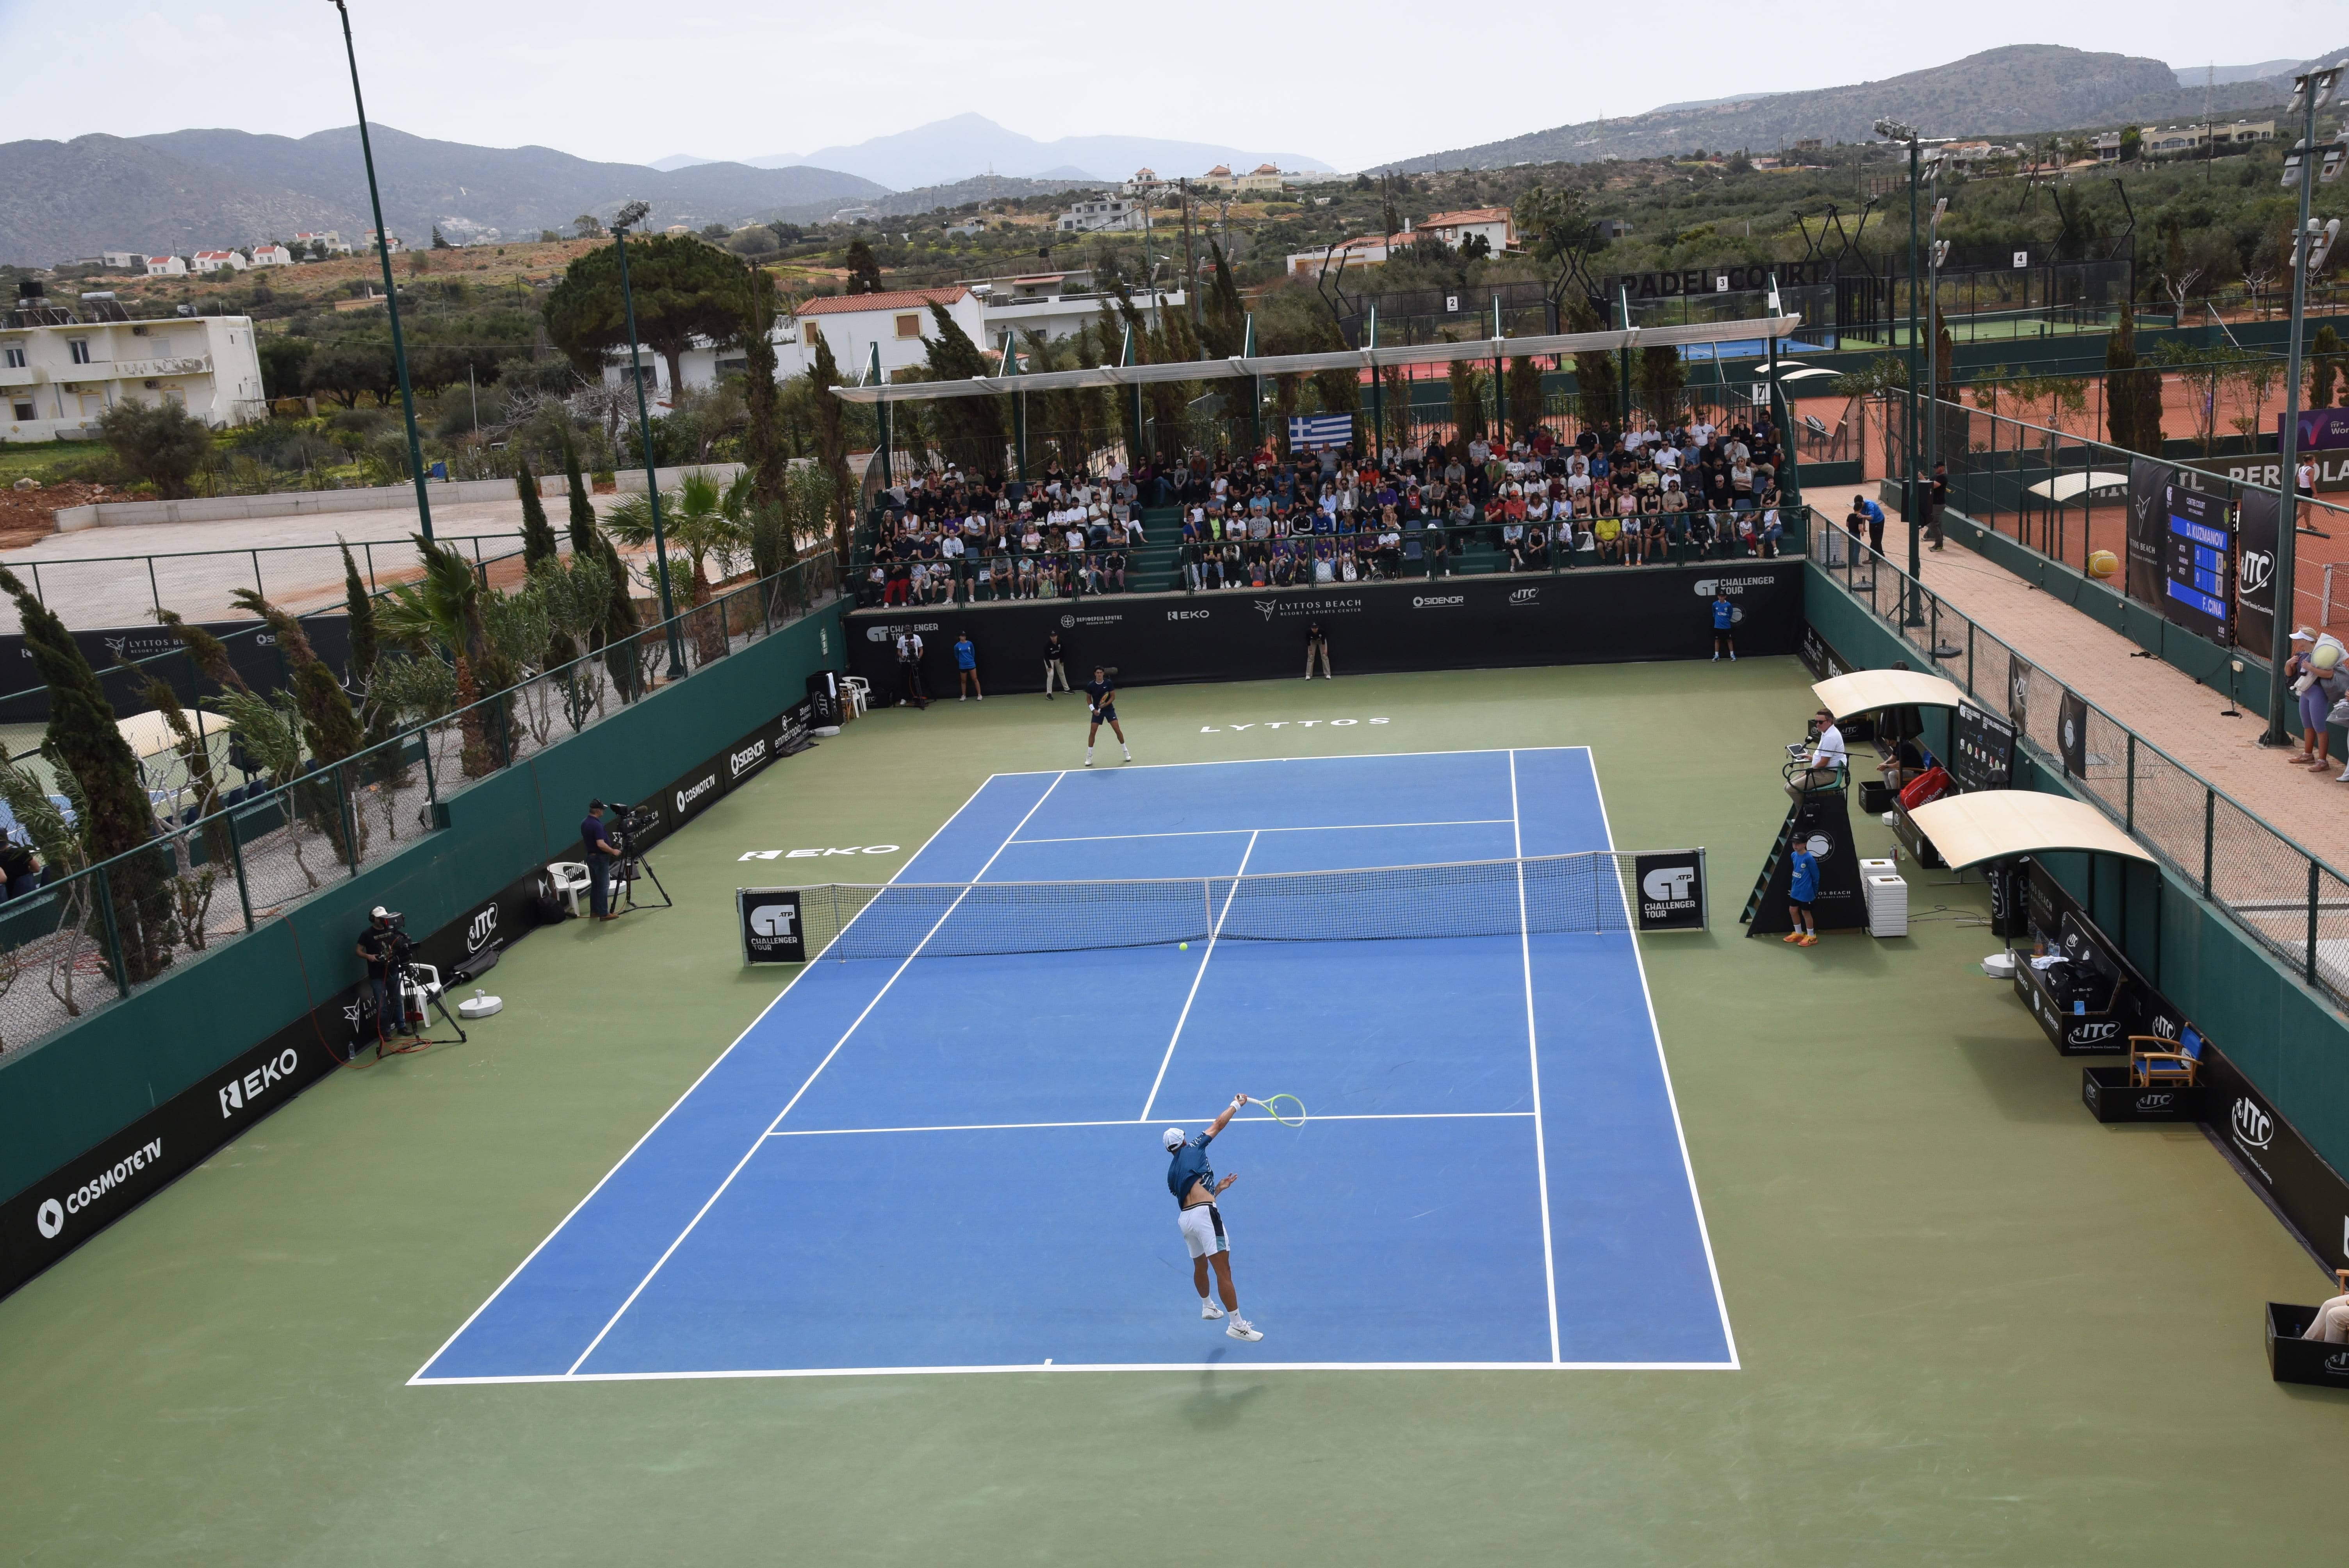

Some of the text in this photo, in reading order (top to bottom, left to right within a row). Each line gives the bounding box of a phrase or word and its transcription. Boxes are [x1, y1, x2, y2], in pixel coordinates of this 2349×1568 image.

[2018, 254, 2023, 262] 4
[1621, 262, 1824, 297] PADEL COURT
[1757, 385, 1765, 397] 7
[2230, 459, 2349, 487] PERLA
[2186, 497, 2206, 509] CENTRE COURT
[2187, 523, 2224, 547] D. KUZMANOV
[2140, 543, 2155, 554] BEACH
[2197, 550, 2221, 568] 0 0
[2244, 550, 2269, 587] ITC
[1720, 576, 1774, 587] CHALLENGER
[2196, 572, 2220, 590] 0 0
[1424, 596, 1464, 606] SIDENOR
[1517, 588, 1536, 599] ITC
[1280, 599, 1361, 610] LYTTOS BEACH
[2203, 597, 2222, 617] F. CINA
[2249, 601, 2258, 610] Tennis
[2257, 605, 2273, 616] Coaching
[1180, 610, 1209, 619] EKO
[890, 623, 939, 633] CHAENGER
[129, 639, 169, 647] LYTTOS
[1200, 718, 1390, 732] LYTTOS
[775, 723, 801, 748] emmetropia
[738, 739, 765, 768] SIDENOR
[685, 774, 715, 803] COSMOTE TV
[649, 820, 659, 829] CENTER
[785, 845, 900, 858] EKO
[1644, 900, 1695, 911] CHALLENGER
[2038, 889, 2052, 912] BEACH
[1645, 910, 1667, 918] TOUR
[475, 907, 497, 939] ITC
[751, 937, 797, 945] CHALLENGER
[2020, 975, 2028, 991] EKO
[2083, 1023, 2116, 1038] ITC
[2158, 1015, 2173, 1039] ITC
[243, 1048, 298, 1100] EKO
[2147, 1094, 2171, 1105] ITC
[2243, 1097, 2270, 1150] ITC
[2233, 1134, 2272, 1185] International Tennis Coaching
[66, 1137, 161, 1214] COSMOTE TV
